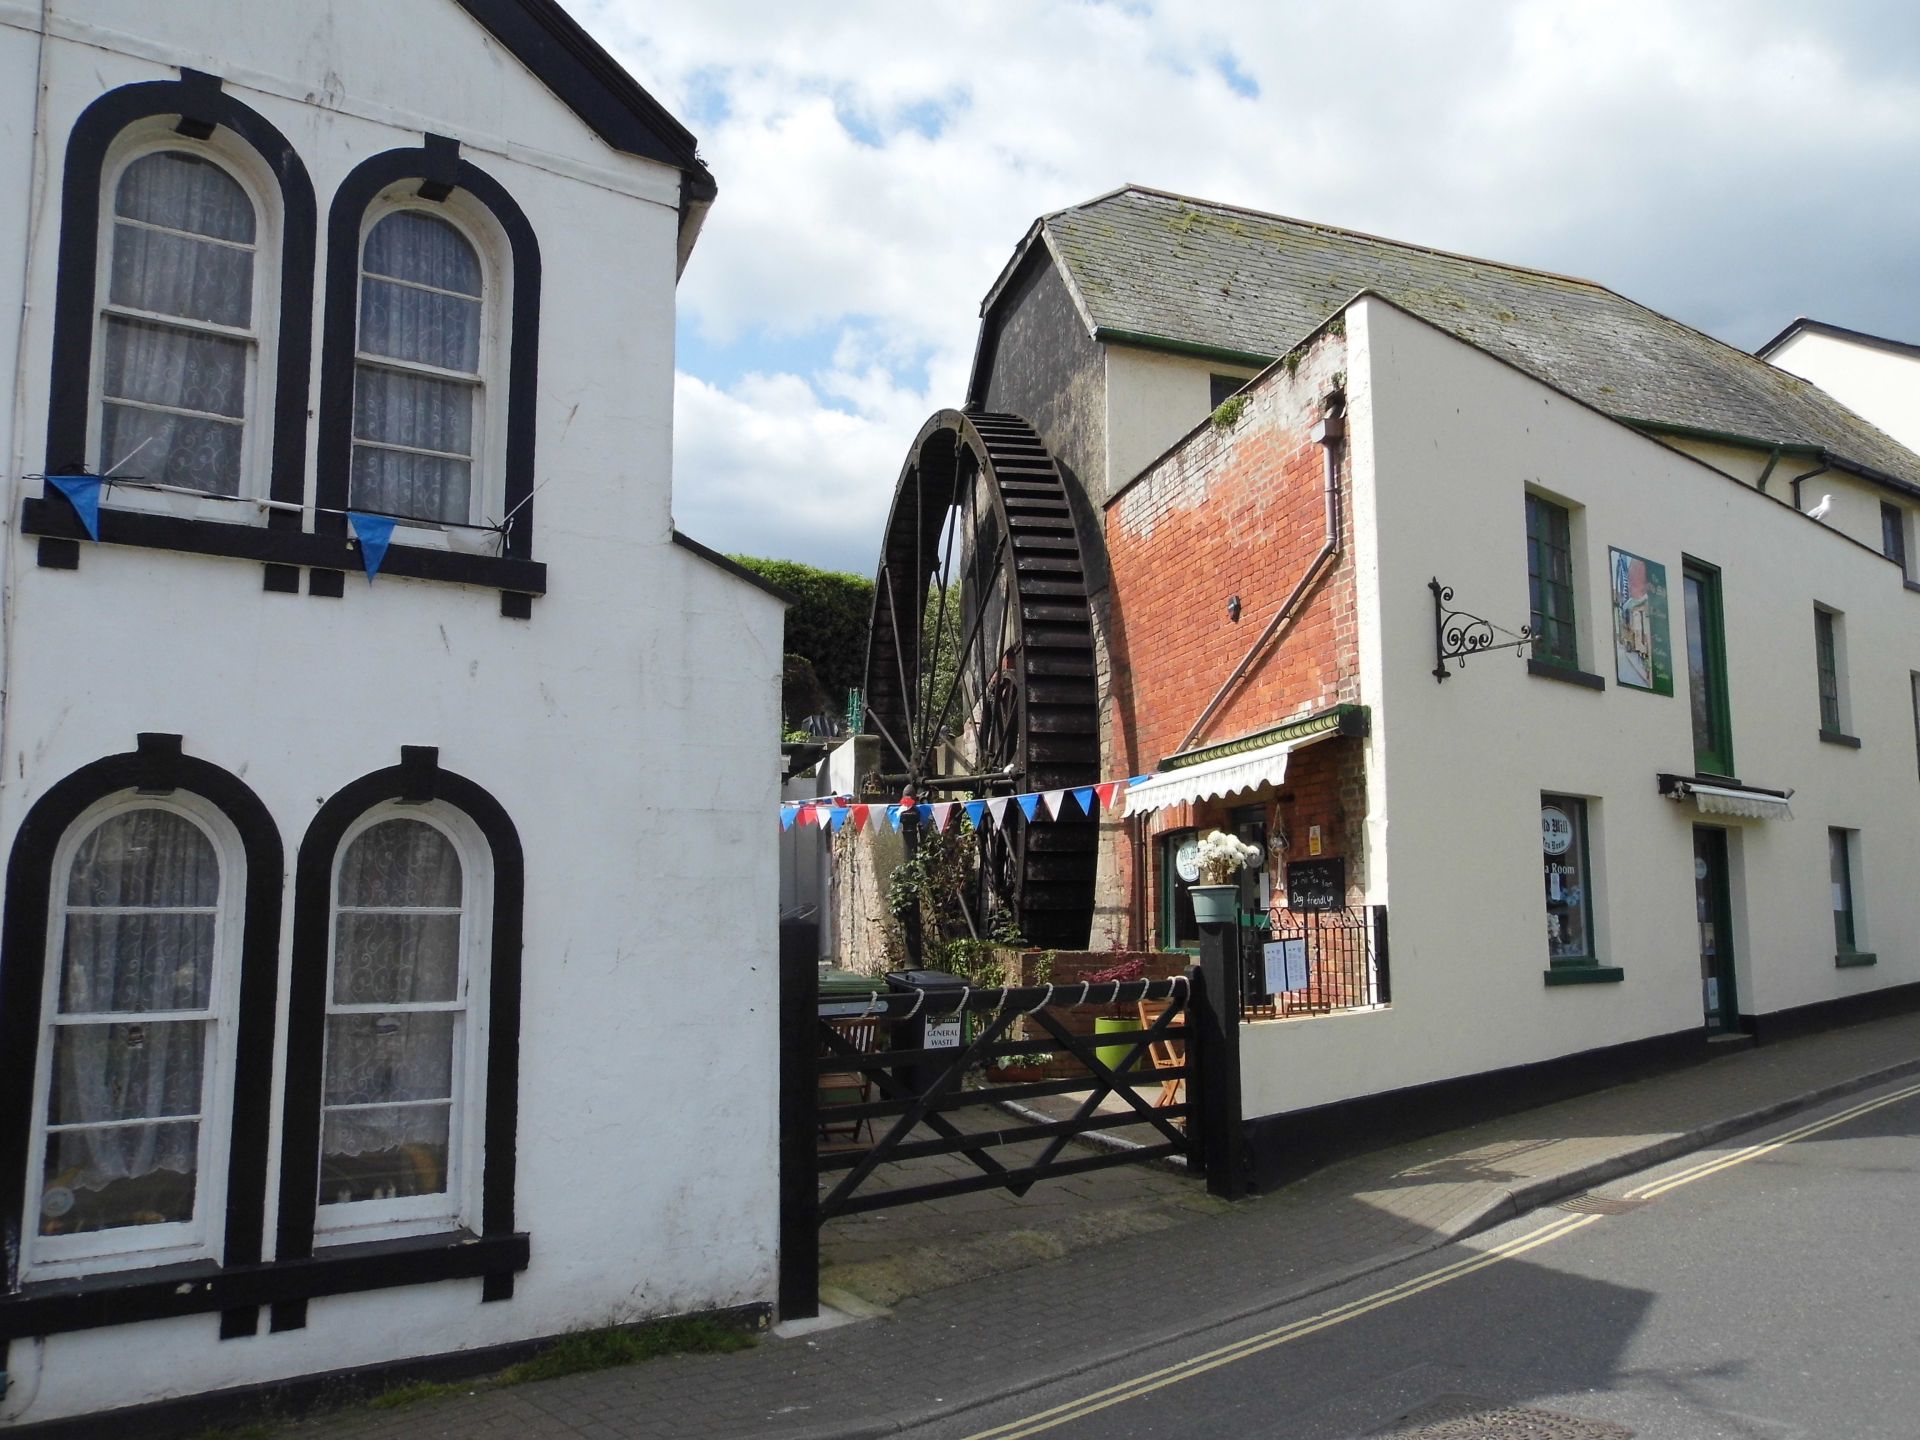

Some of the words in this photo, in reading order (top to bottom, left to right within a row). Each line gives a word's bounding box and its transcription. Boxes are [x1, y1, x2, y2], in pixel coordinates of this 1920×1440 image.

[1542, 819, 1550, 832] ld
[1552, 819, 1568, 833] Mill
[1551, 862, 1575, 874] Room
[1293, 892, 1304, 907] Dog
